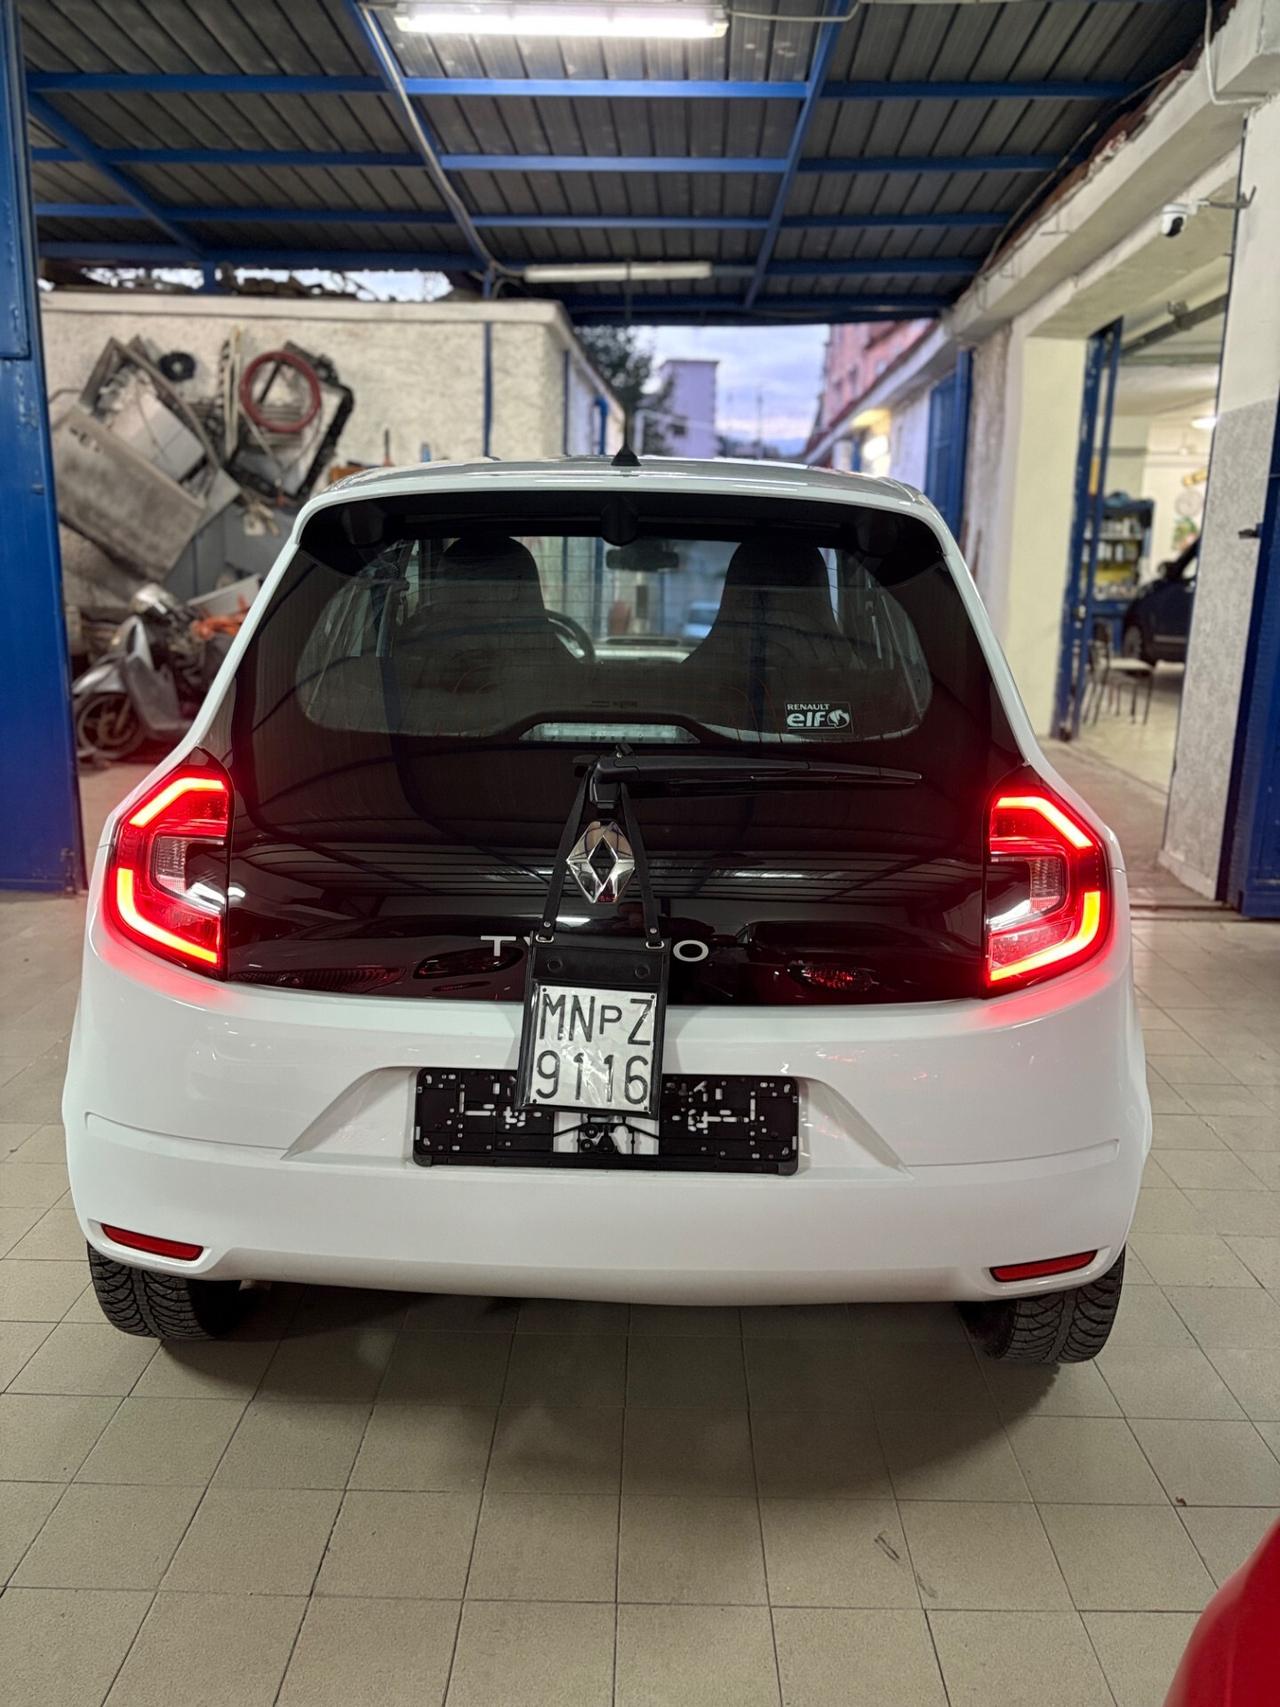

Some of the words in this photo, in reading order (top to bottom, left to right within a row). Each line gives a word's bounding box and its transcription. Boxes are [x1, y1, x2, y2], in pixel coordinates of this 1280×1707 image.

[786, 703, 830, 711] RENAULT
[786, 711, 826, 727] elf
[536, 1049, 649, 1105] 9116
